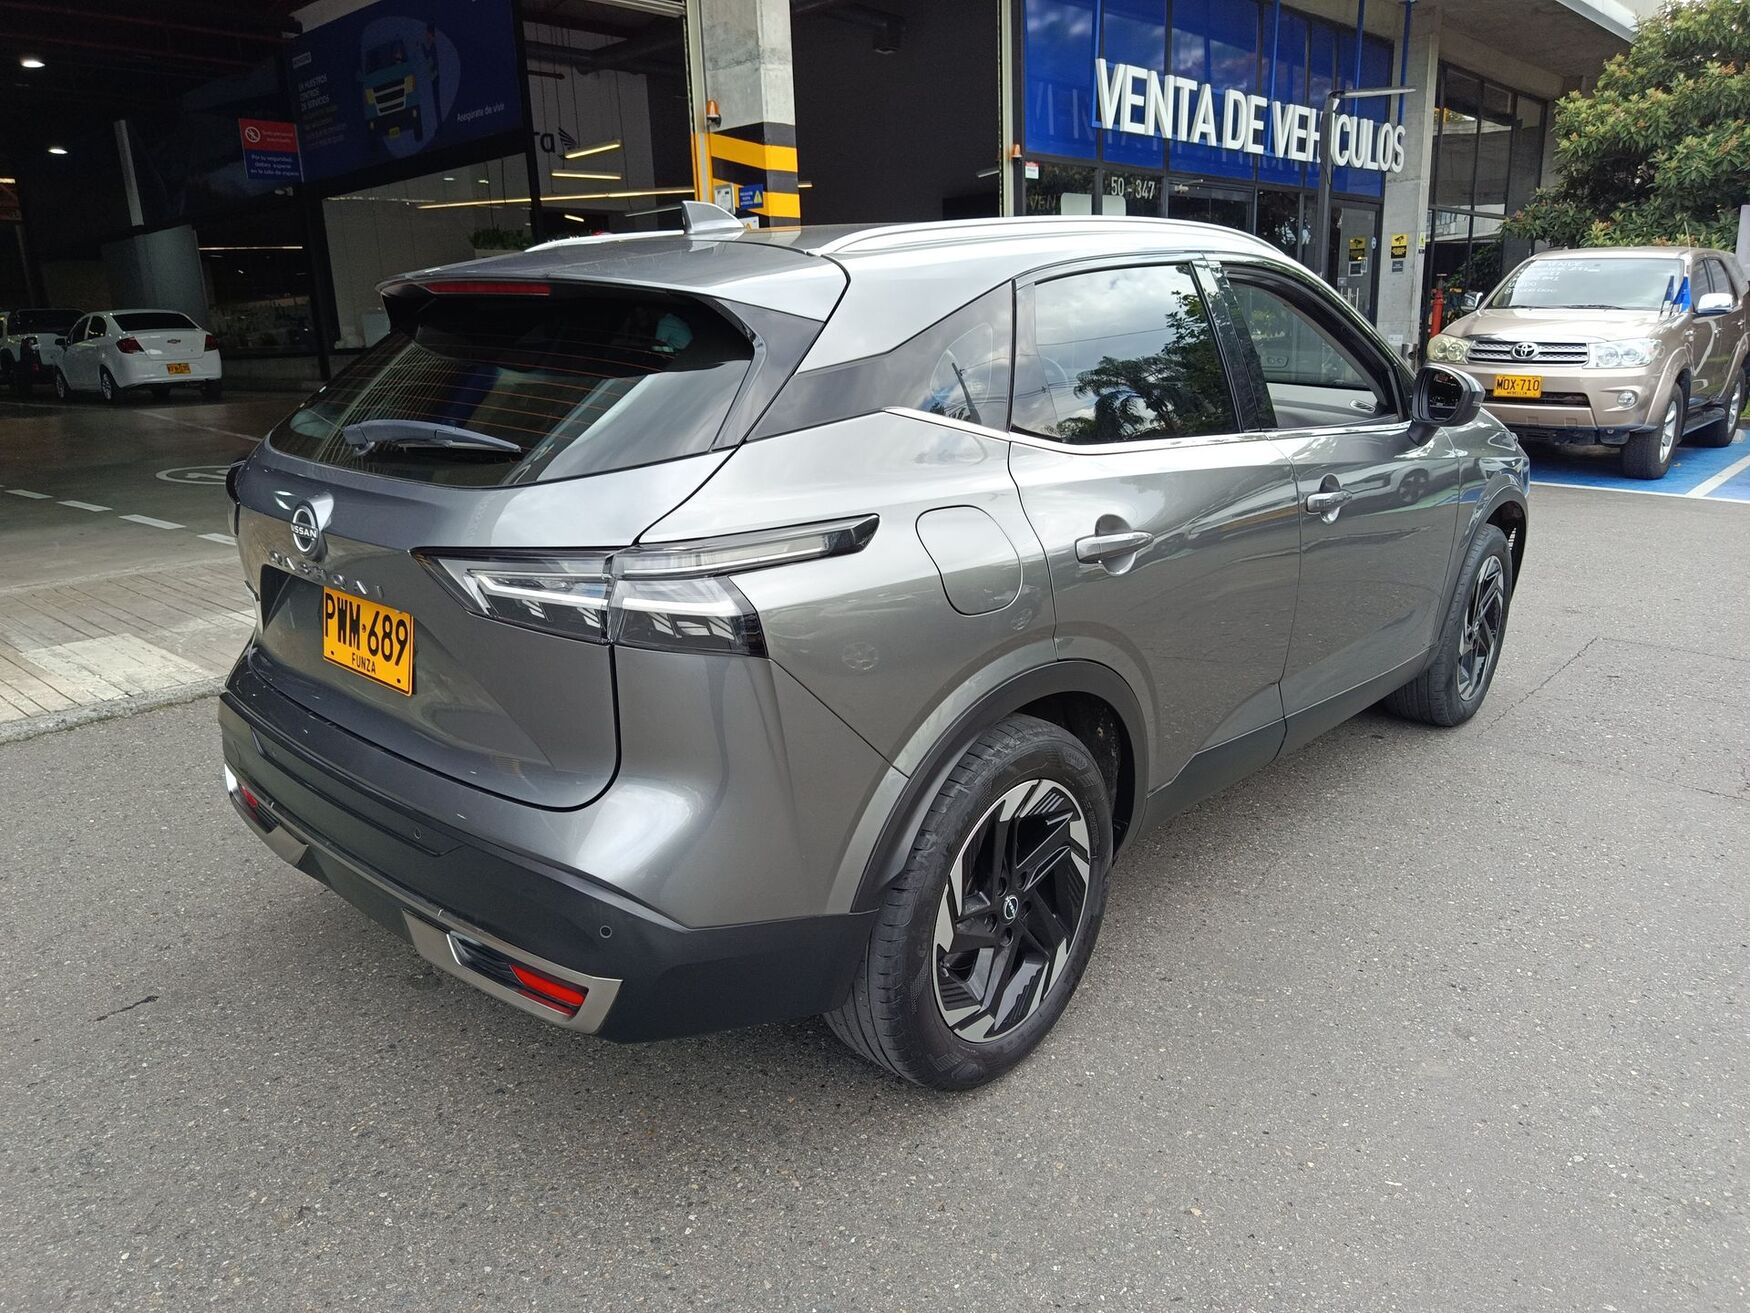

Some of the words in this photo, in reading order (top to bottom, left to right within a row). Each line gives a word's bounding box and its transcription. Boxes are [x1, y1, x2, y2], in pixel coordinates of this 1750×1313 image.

[1095, 58, 1217, 146] VENTA
[1222, 89, 1268, 155] DE
[1111, 176, 1125, 196] 50
[1135, 179, 1156, 200] 347
[291, 524, 317, 539] SSAN
[351, 652, 377, 675] FUNZA
